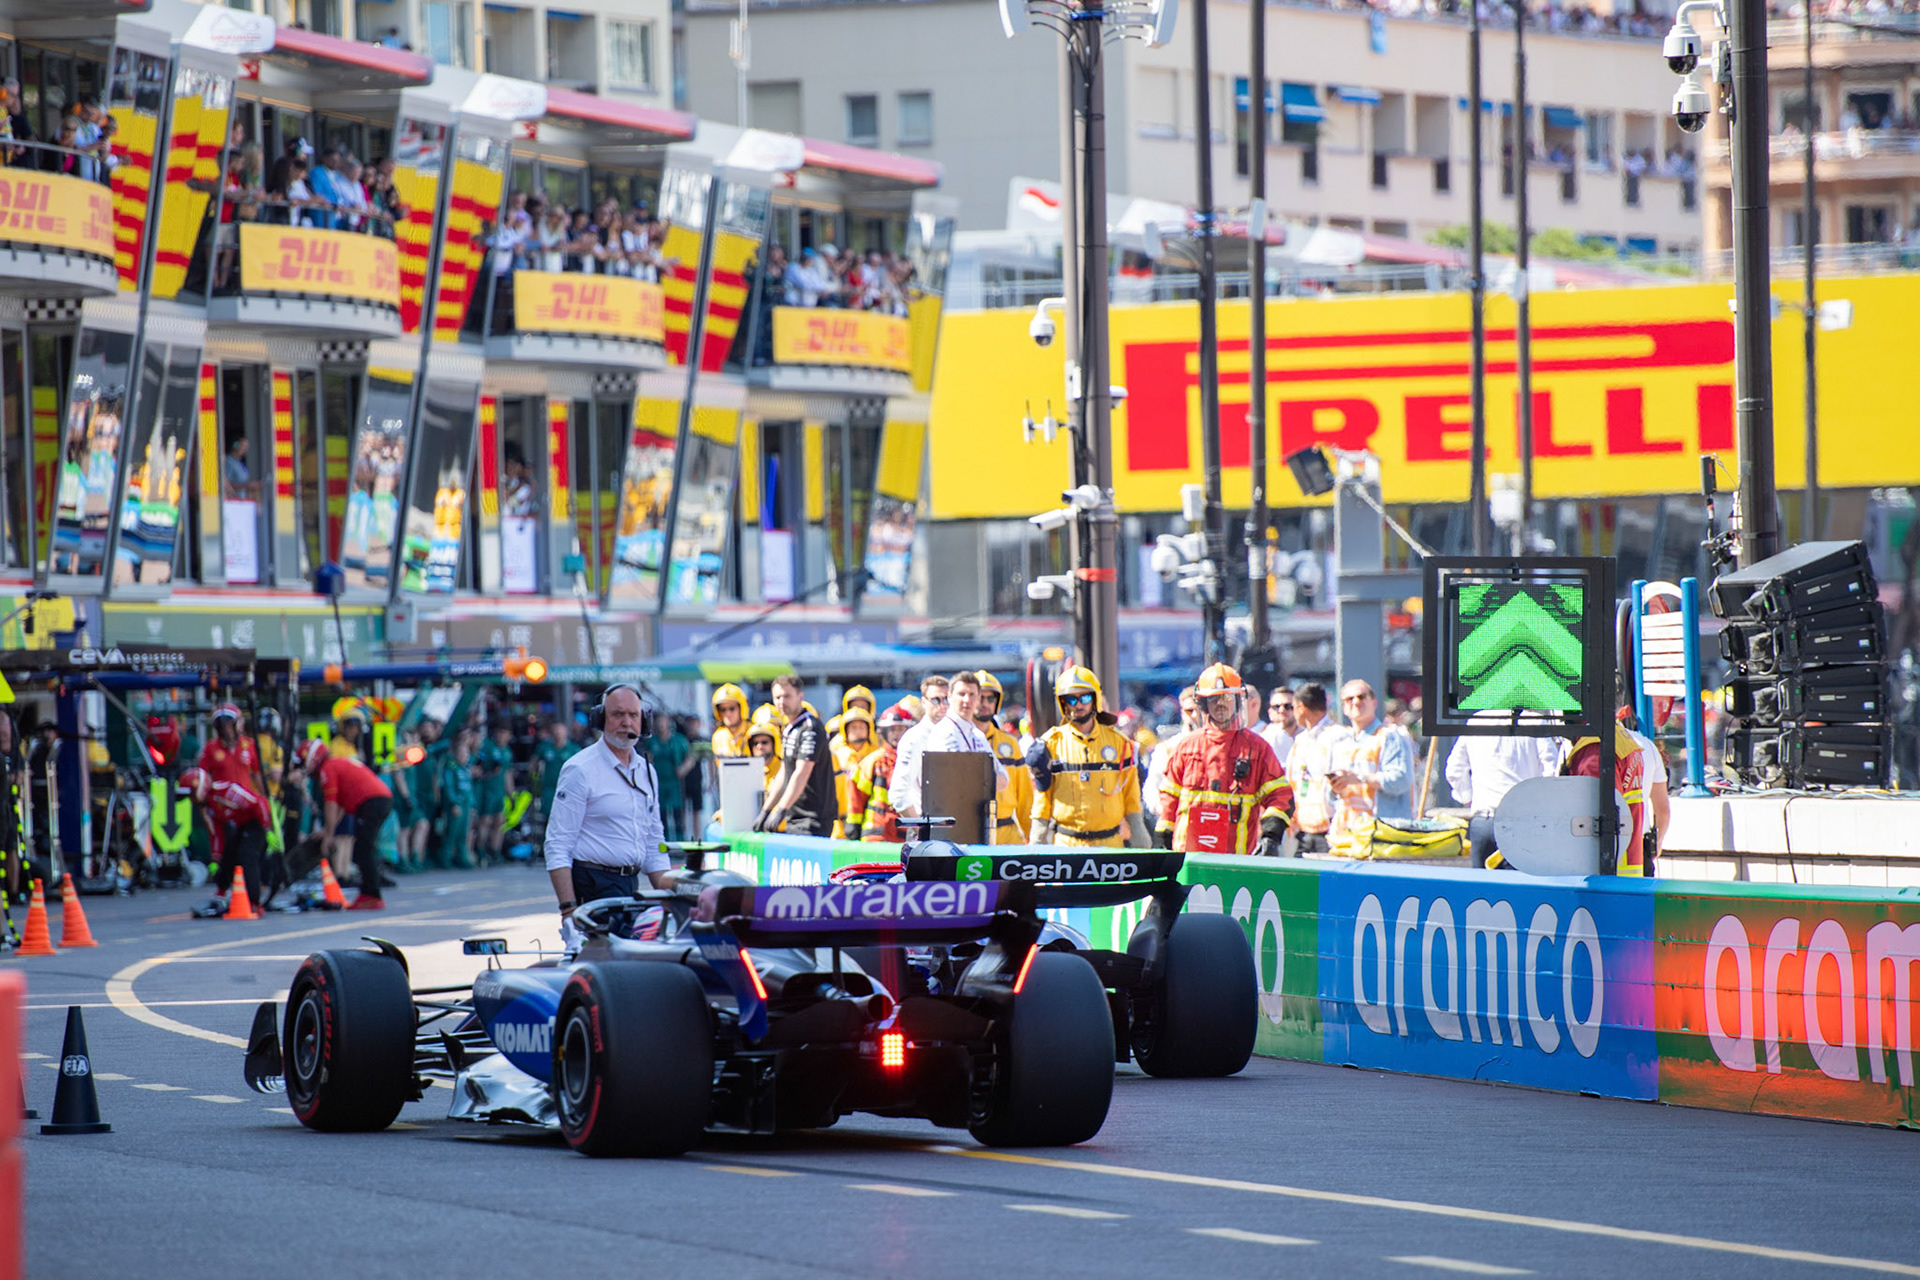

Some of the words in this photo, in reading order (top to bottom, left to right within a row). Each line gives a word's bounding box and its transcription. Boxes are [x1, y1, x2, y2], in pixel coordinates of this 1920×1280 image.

[278, 236, 343, 283] DHL
[551, 283, 609, 321] DHL
[807, 317, 861, 353] DHL
[1125, 320, 1736, 472] PIRELLI
[126, 653, 185, 664] LOGISTICS
[999, 859, 1072, 881] Cash
[1077, 858, 1138, 881] App
[813, 881, 988, 918] kraken
[1352, 893, 1603, 1058] aramco
[1704, 913, 1920, 1087] aram
[494, 1016, 557, 1054] KOMAT
[63, 1059, 89, 1074] FIA
